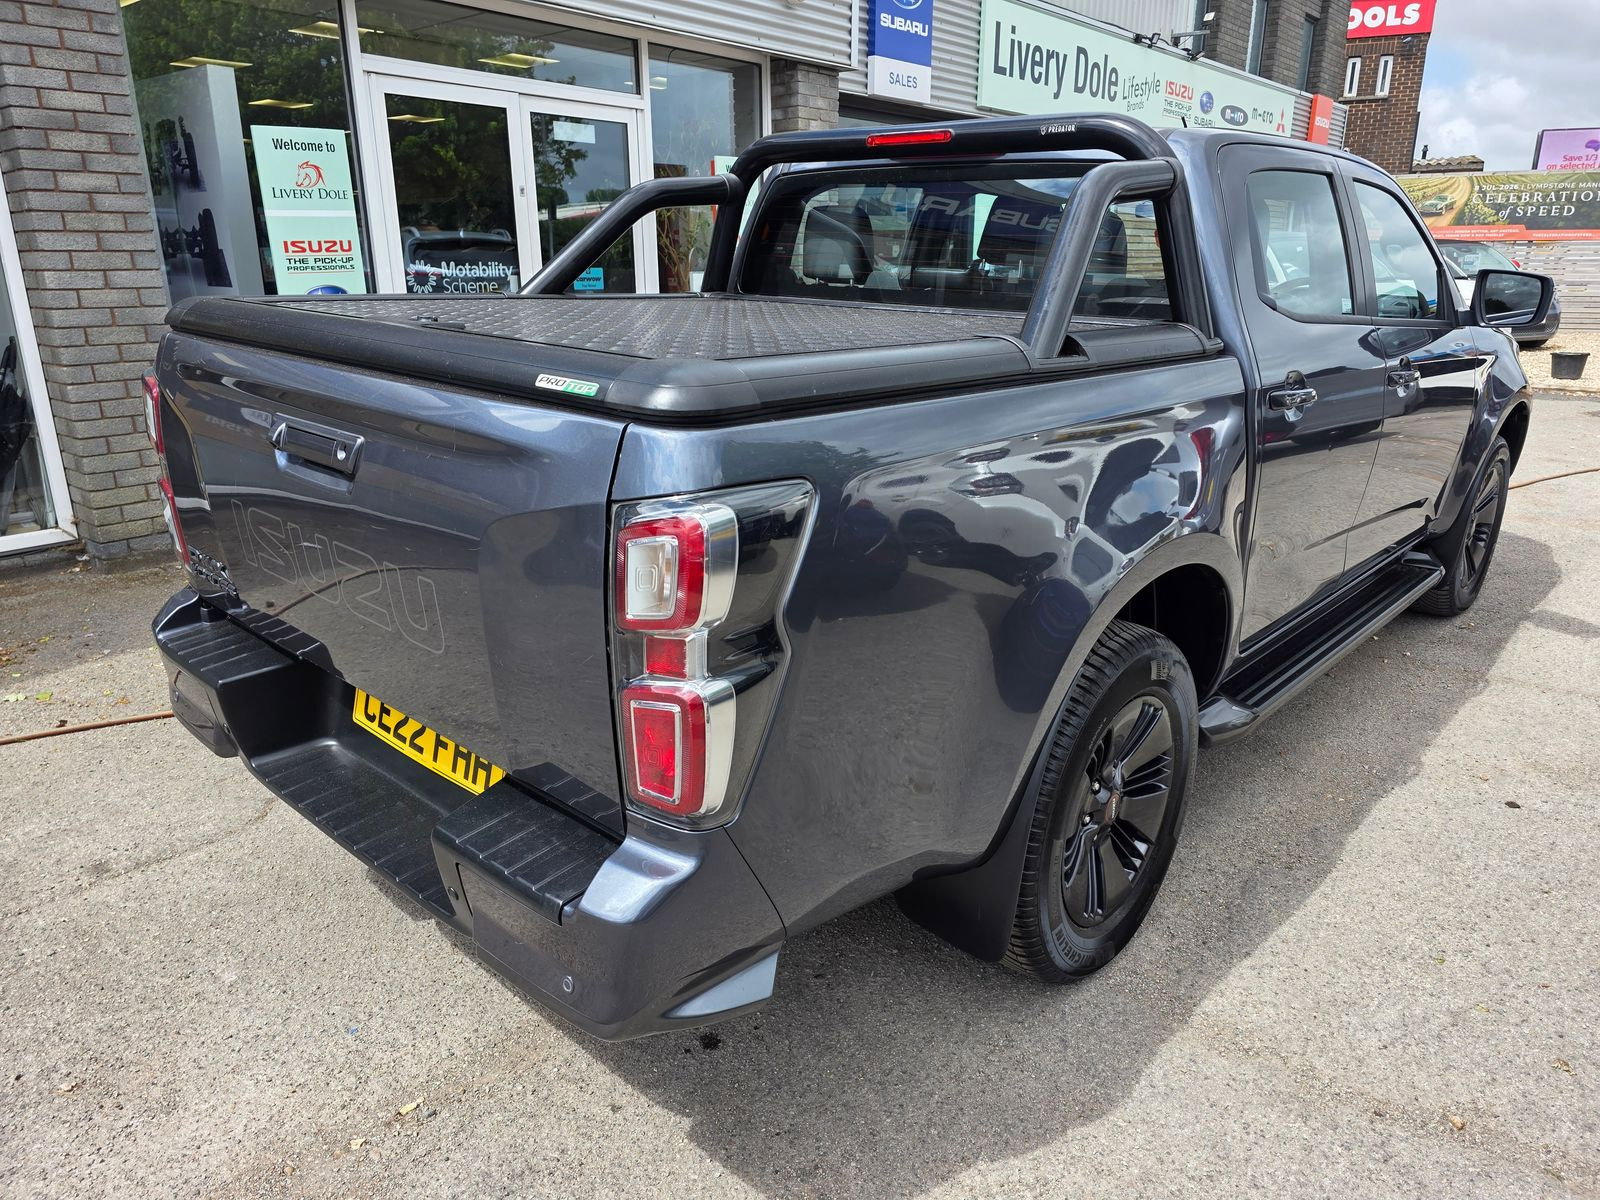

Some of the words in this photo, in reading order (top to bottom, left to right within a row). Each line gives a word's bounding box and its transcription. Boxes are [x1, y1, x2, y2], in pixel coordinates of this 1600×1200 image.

[880, 13, 928, 37] SUBARU
[993, 20, 1068, 100] Livery
[1074, 45, 1119, 102] Dole
[889, 72, 918, 89] SALES
[1122, 72, 1160, 101] Lifestyle
[1165, 80, 1194, 100] ISUZU
[1126, 100, 1145, 112] Brands
[1164, 99, 1174, 108] THE
[1174, 101, 1193, 112] PICK-UP
[1048, 124, 1076, 133] PREDATOR
[1193, 116, 1216, 127] SUBARU
[272, 138, 323, 152] Welcome
[325, 141, 336, 153] to
[1563, 154, 1583, 162] Save
[1560, 161, 1594, 170] selected
[272, 187, 314, 199] LIVERY
[318, 188, 349, 200] DOLE
[1472, 190, 1600, 204] CELEBRATIO
[1498, 205, 1513, 221] of
[1516, 205, 1576, 217] SPEED
[283, 240, 353, 254] ISUZU
[314, 256, 354, 265] PICK-UP
[287, 264, 355, 272] PROFESSIONALS
[441, 261, 514, 279] Motability
[442, 279, 498, 294] Scheme
[231, 499, 445, 654] ISUZU
